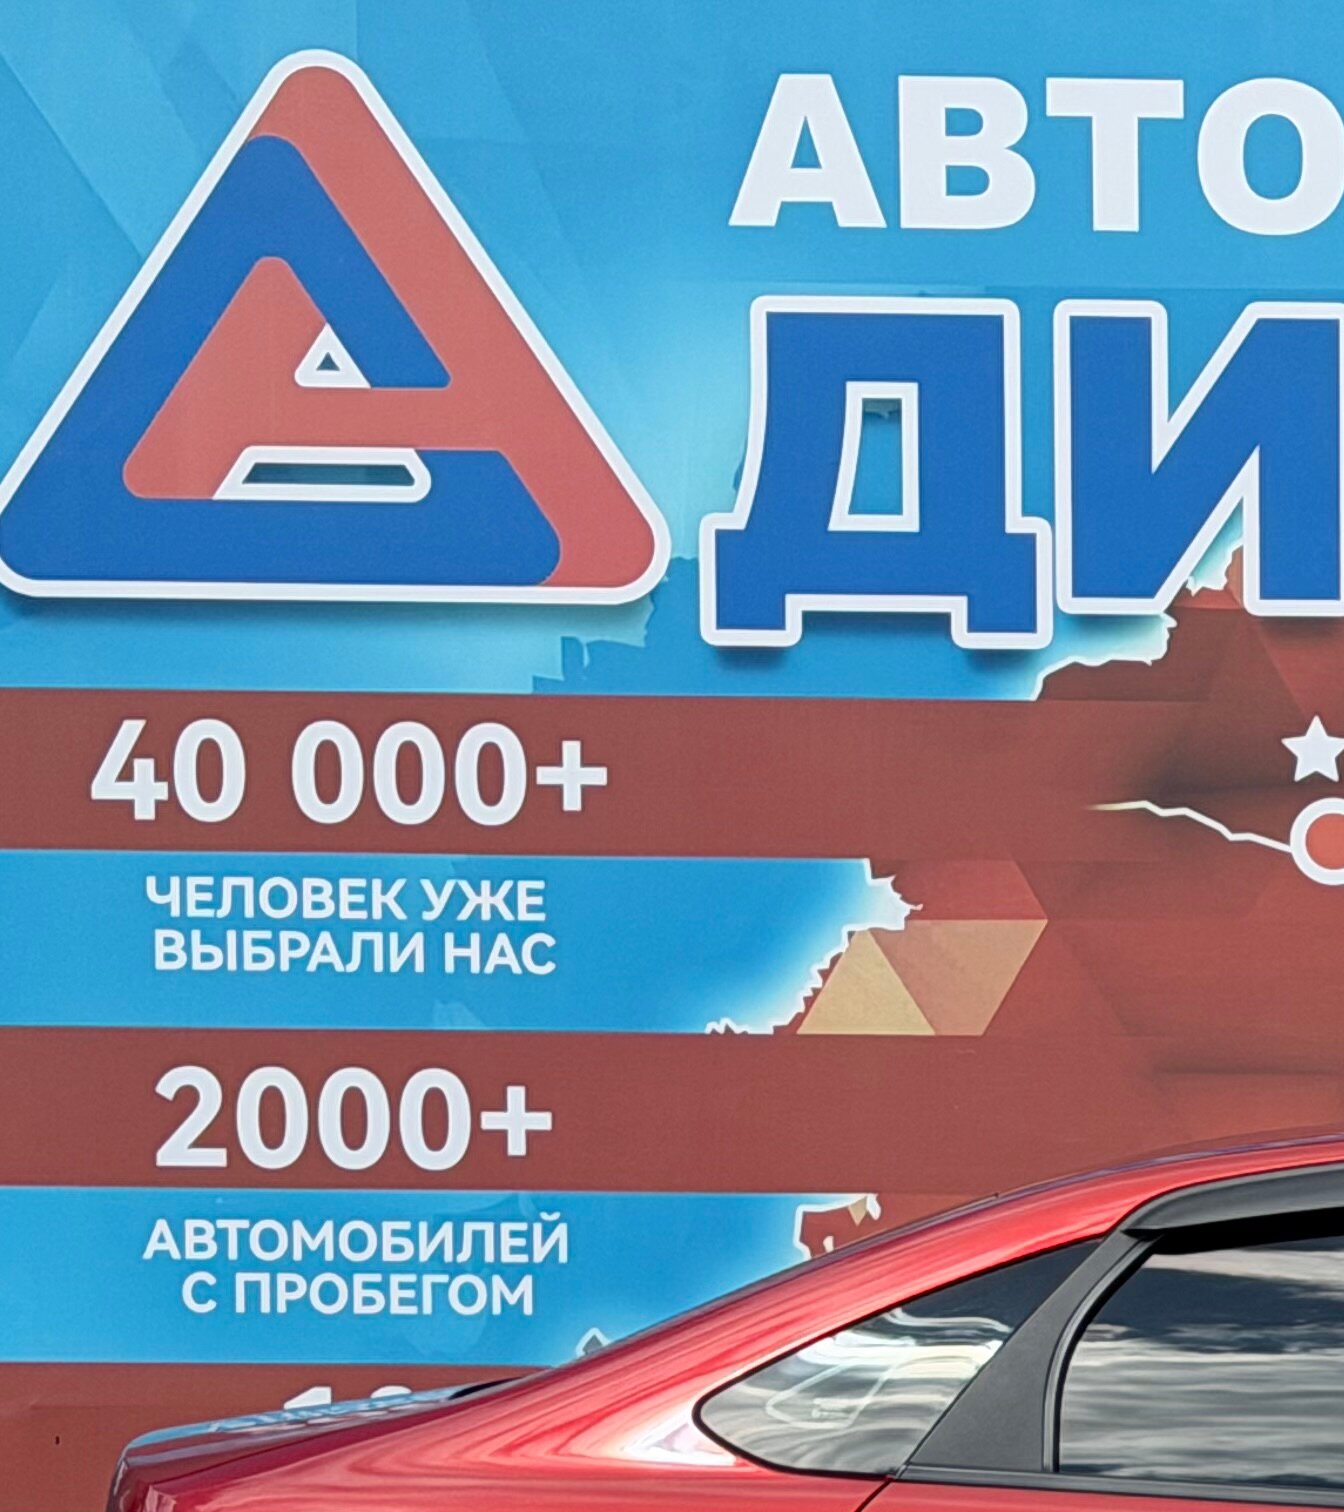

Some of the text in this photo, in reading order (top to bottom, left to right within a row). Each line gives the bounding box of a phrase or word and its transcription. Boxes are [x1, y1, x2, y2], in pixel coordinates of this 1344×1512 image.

[91, 718, 608, 826] 40 000+
[145, 876, 546, 921] ЧЕЛОВЕК УЖЕ
[154, 929, 557, 975] ВЫБРАЛИ НАС
[155, 1065, 552, 1171] 2000+
[143, 1212, 568, 1263] АВТОМОБИЛЕЙ
[181, 1271, 534, 1315] С ПРОБЕГОМ
